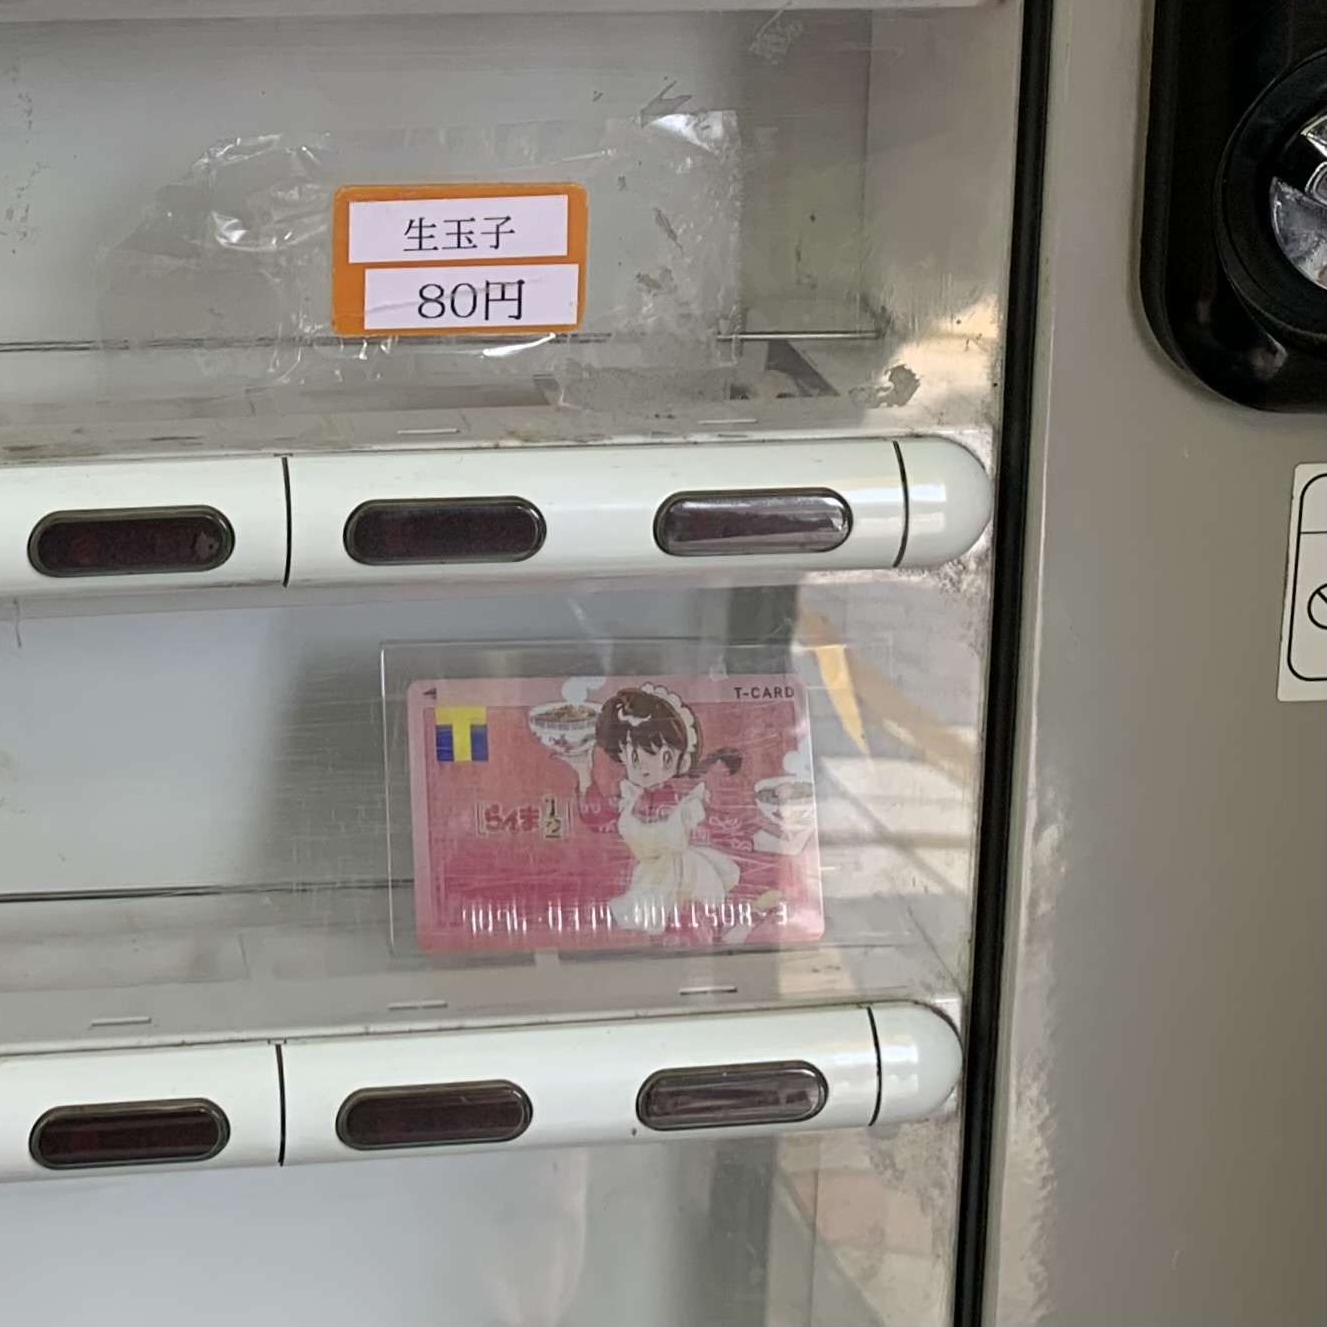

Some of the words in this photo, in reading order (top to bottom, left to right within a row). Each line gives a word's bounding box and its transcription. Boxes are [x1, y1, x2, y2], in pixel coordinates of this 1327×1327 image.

[404, 216, 515, 251] 生玉子
[418, 279, 525, 320] 80円
[734, 686, 794, 699] T-CARD
